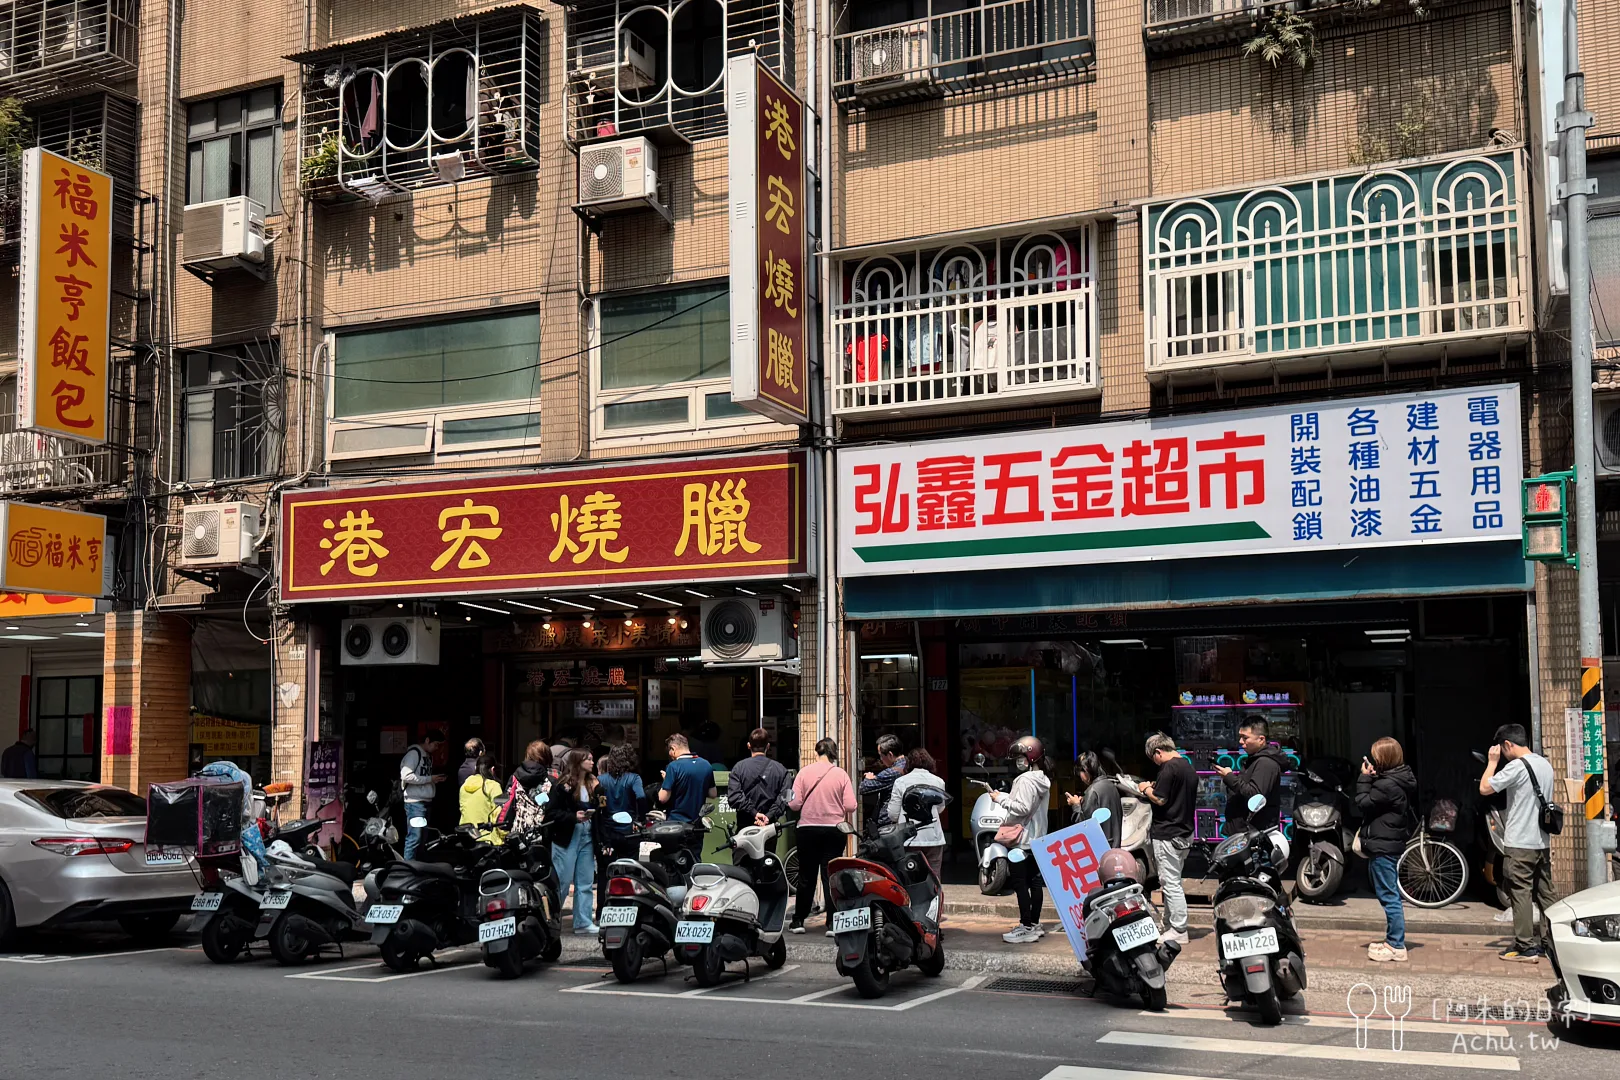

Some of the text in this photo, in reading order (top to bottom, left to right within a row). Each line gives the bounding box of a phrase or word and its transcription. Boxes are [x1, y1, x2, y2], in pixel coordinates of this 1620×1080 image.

[765, 96, 798, 394] 港宏燒臘
[49, 168, 97, 428] 福米亨飯包
[853, 430, 1265, 535] 弘鑫五金超市
[1290, 412, 1323, 541] 開裝配鎖
[1347, 407, 1382, 538] 各種油漆
[1407, 402, 1442, 534] 建材五金
[1468, 396, 1503, 530] 電器用品
[45, 533, 102, 573] 福米亨
[319, 477, 763, 578] 港宏燒臘
[526, 665, 628, 687] 港宏燒臘
[933, 680, 947, 690] 127
[1046, 833, 1102, 899] 租
[677, 926, 713, 939] NZX-0292
[1224, 934, 1276, 954] MAM-1228
